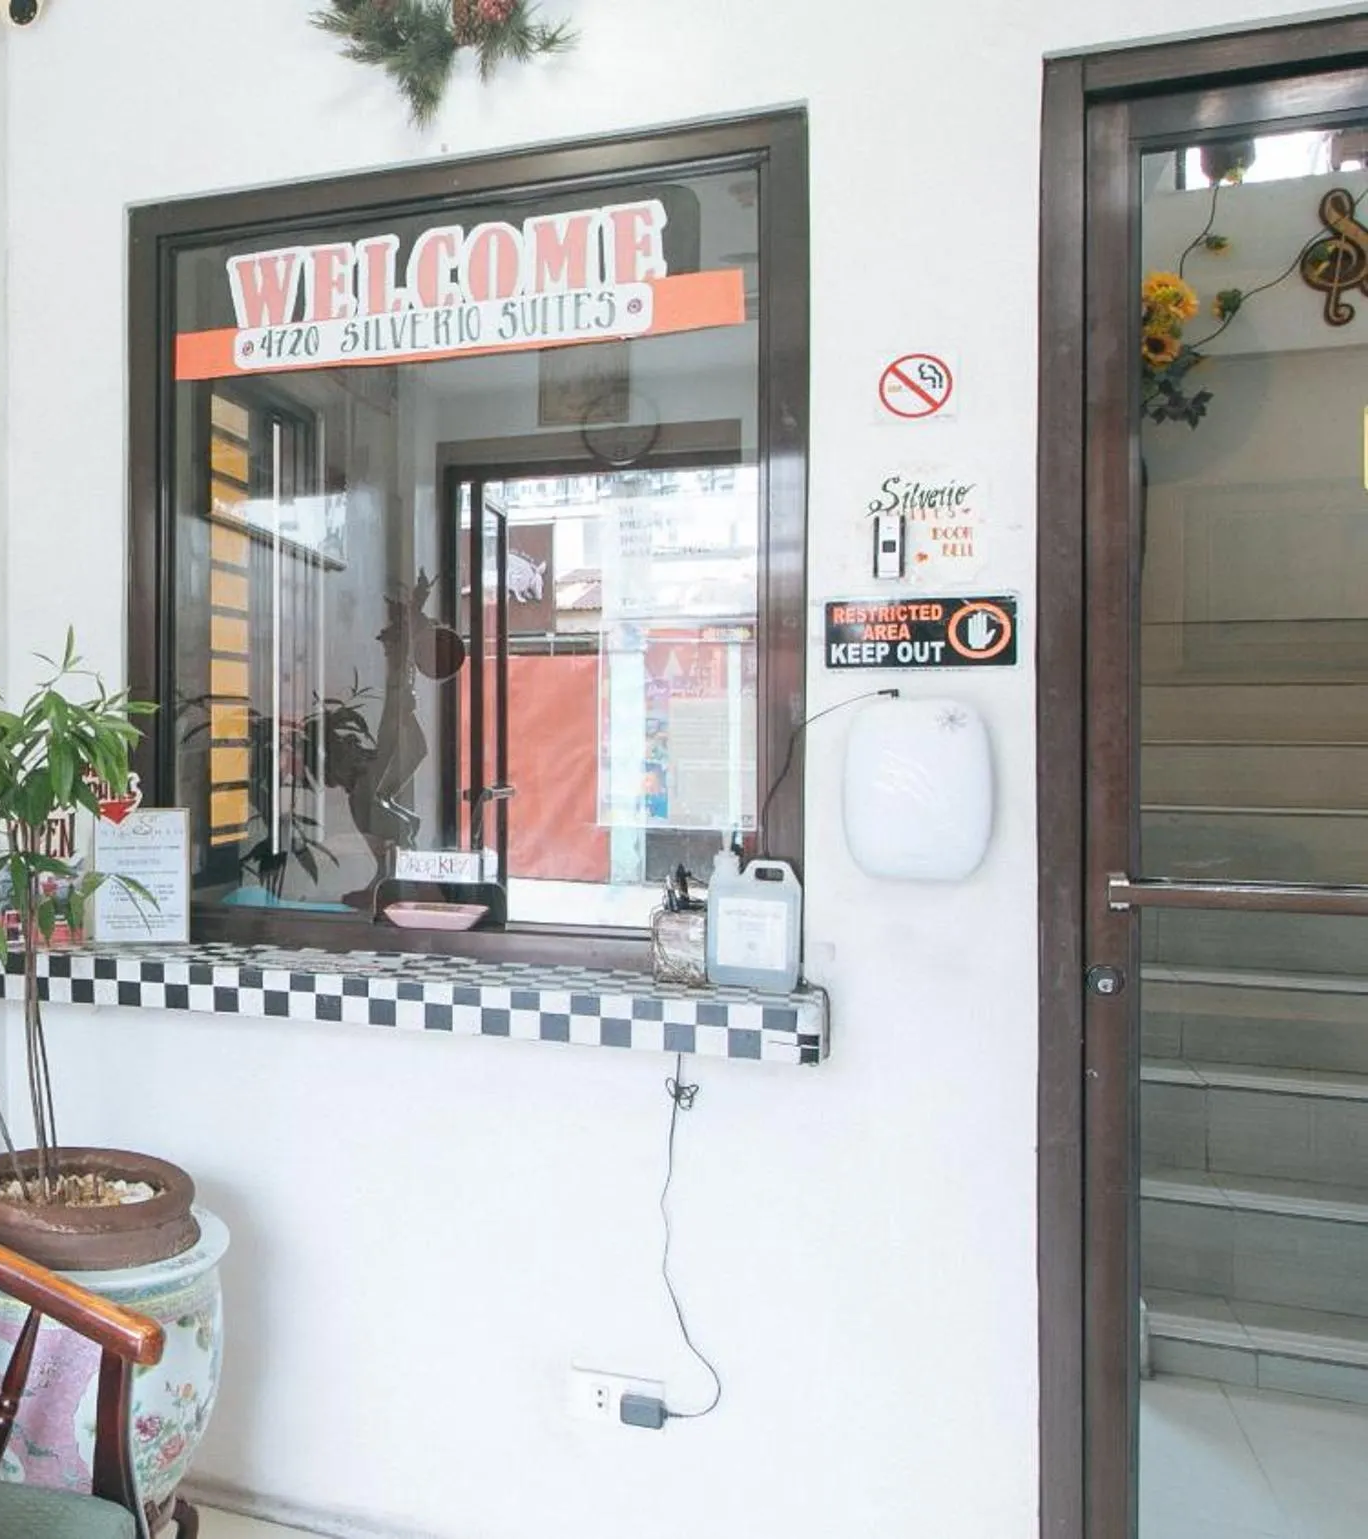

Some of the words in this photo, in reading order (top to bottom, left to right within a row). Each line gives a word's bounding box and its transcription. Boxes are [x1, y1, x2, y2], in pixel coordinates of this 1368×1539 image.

[236, 207, 654, 329] WELCOME
[260, 325, 320, 358] 4720
[340, 304, 482, 353] SILVERIO
[498, 289, 616, 340] SUITES
[865, 476, 976, 517] Silverio
[832, 603, 944, 624] RESTRICTED
[863, 623, 911, 641] AREA
[831, 643, 889, 665] KEEP
[896, 641, 946, 663] OUT
